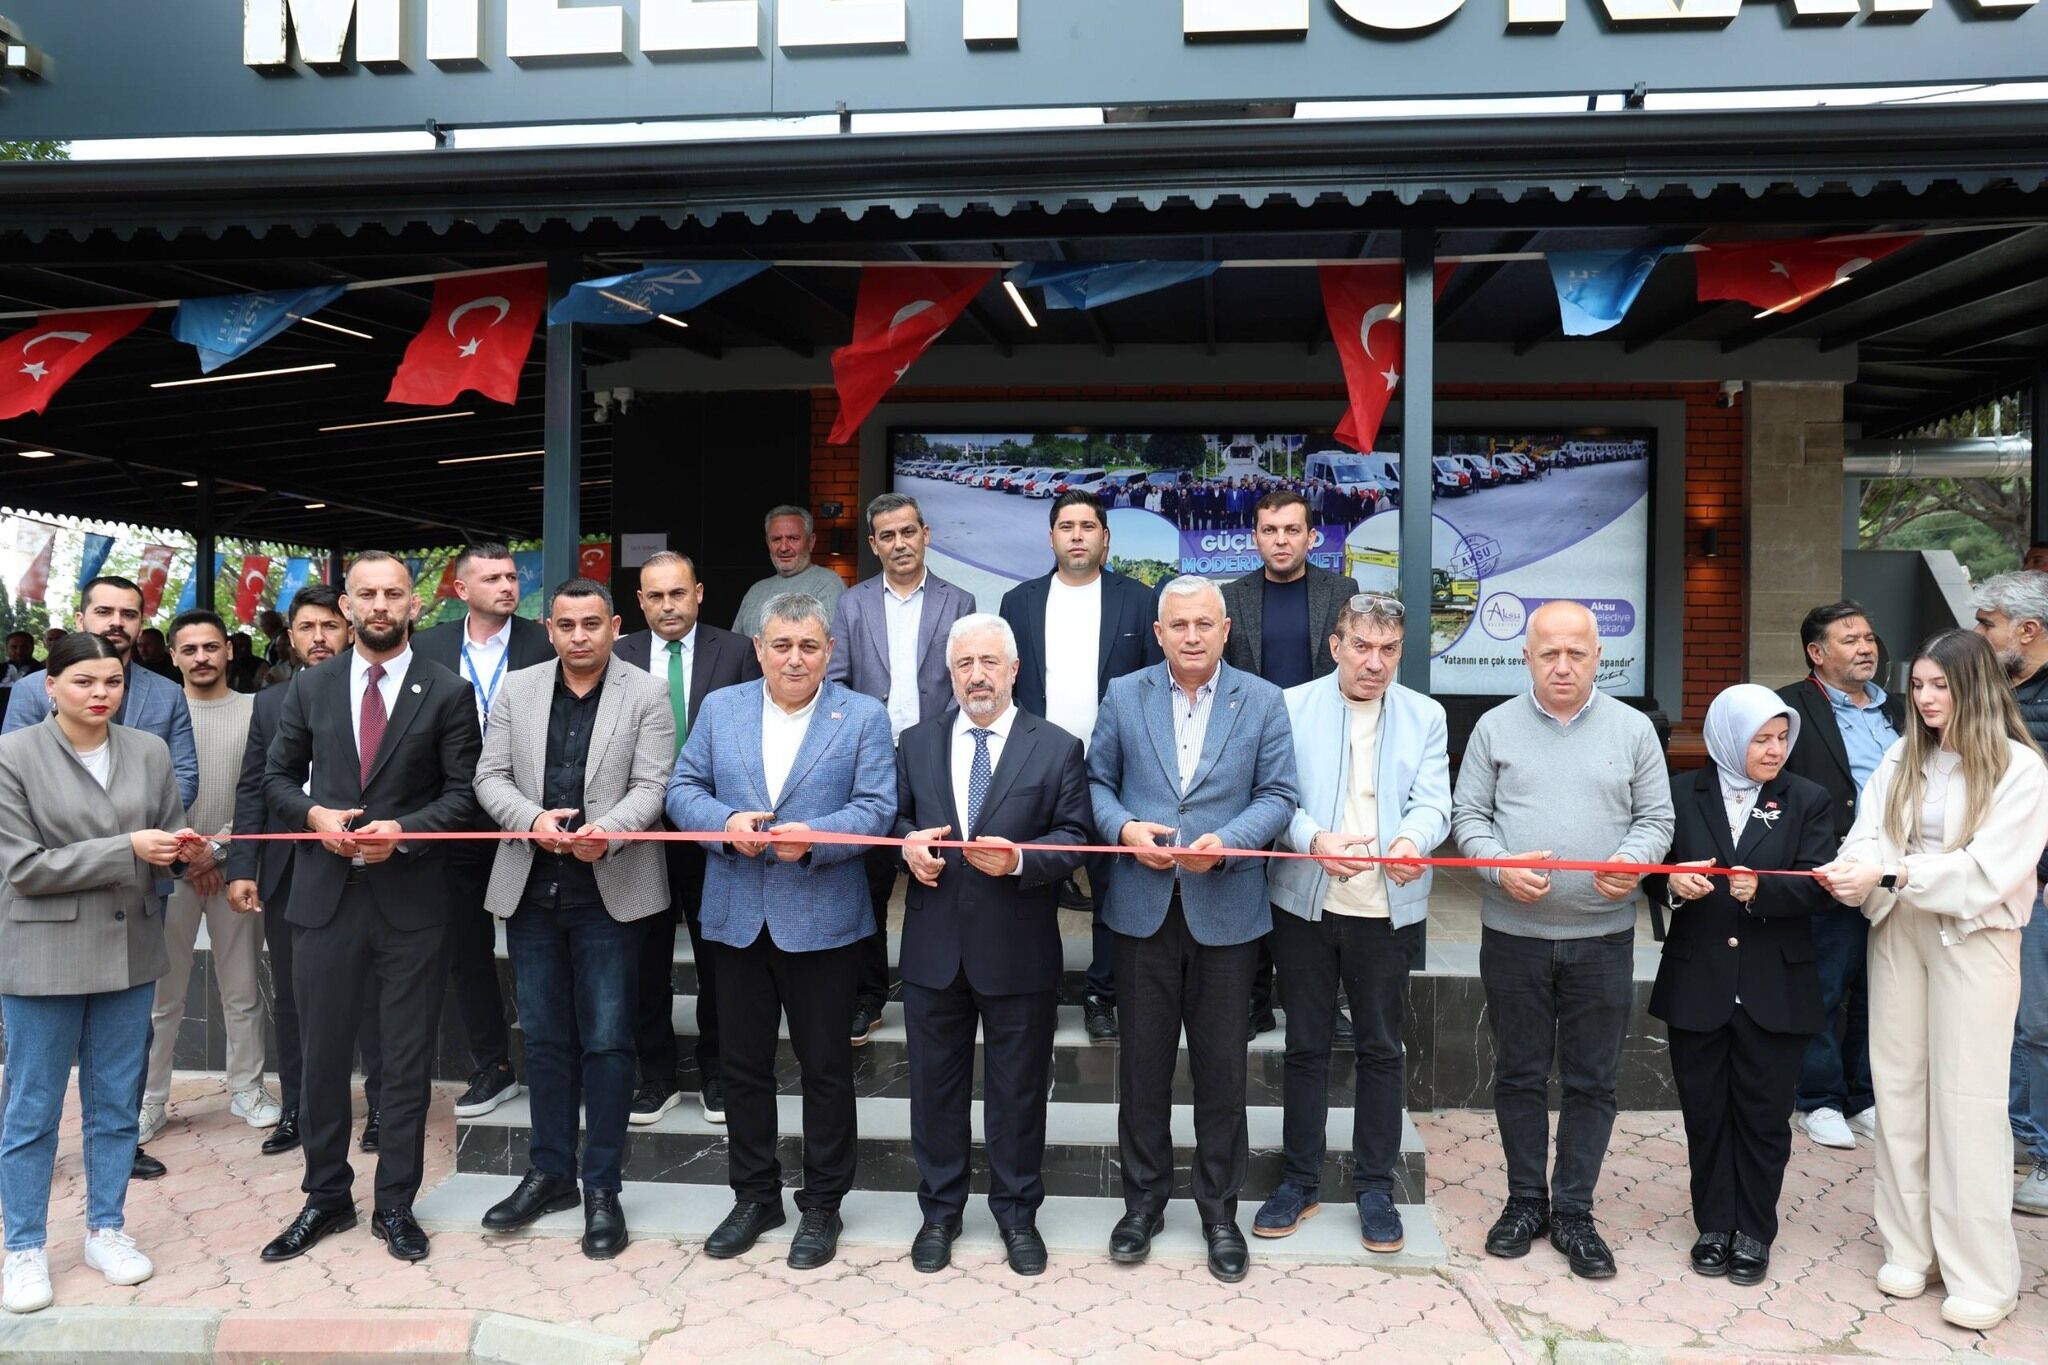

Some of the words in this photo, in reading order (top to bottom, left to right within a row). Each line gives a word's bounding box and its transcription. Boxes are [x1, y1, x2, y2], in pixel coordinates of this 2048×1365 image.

[1200, 531, 1257, 555] GÜÇL
[1487, 601, 1521, 622] Aksu
[1591, 601, 1616, 612] Aksu
[1597, 612, 1631, 625] elediye
[1479, 656, 1489, 665] en
[1491, 655, 1506, 668] çok
[1508, 657, 1527, 666] seve
[1600, 656, 1635, 669] apandır"
